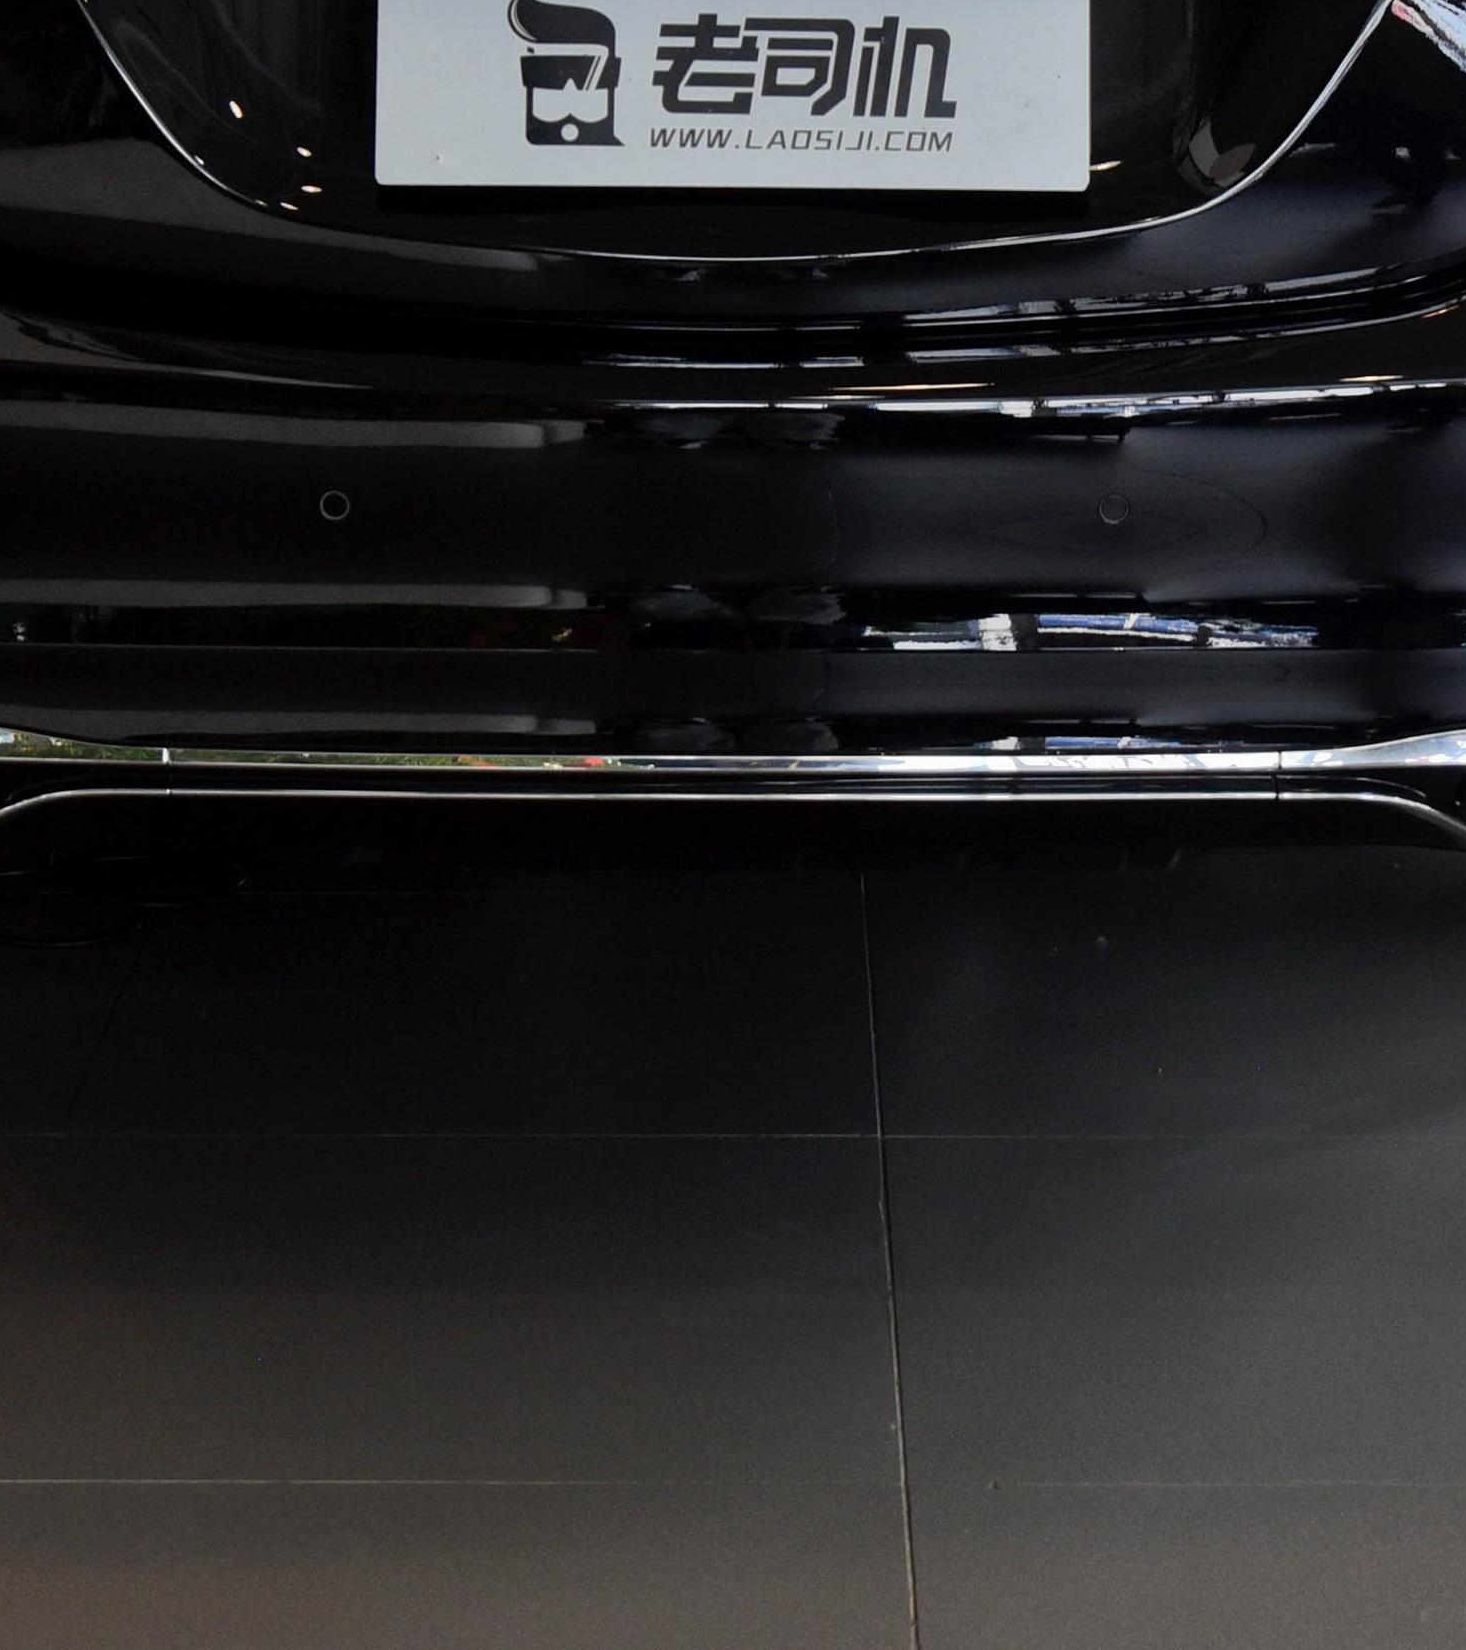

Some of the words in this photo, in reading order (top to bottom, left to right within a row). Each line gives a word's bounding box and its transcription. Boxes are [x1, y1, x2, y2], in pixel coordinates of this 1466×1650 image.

[651, 13, 957, 119] 老司机
[649, 127, 954, 153] WWW.LAOSIJI.COM
